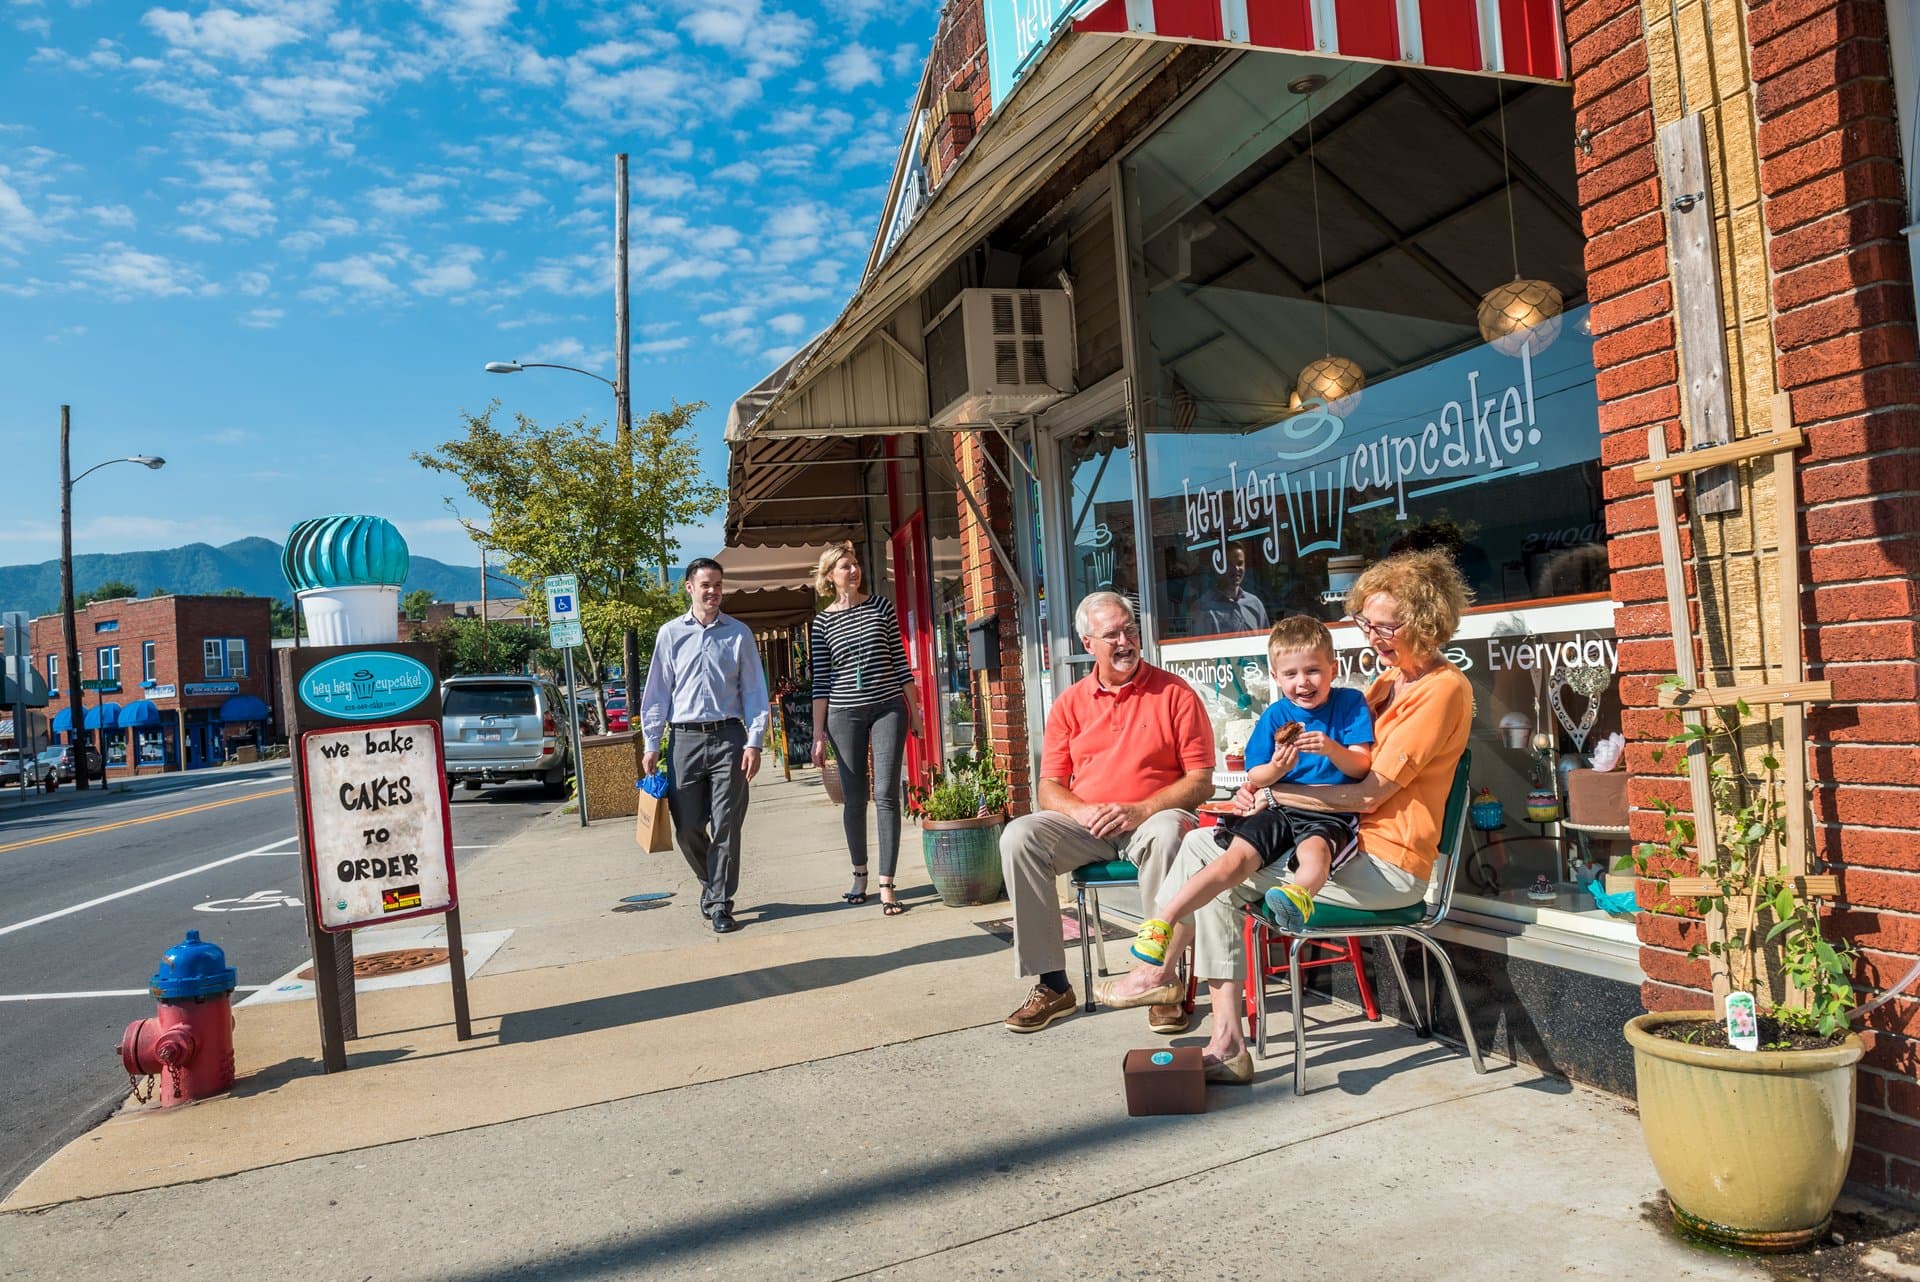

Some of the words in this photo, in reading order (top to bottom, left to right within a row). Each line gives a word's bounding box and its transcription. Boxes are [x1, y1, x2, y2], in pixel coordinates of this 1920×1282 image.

[1182, 477, 1228, 575] hey
[1229, 461, 1280, 564] hey
[1351, 341, 1542, 521] cupcake!
[1487, 633, 1623, 676] Everyday
[312, 680, 332, 703] hey
[333, 678, 352, 701] hey
[375, 669, 422, 694] cupcake!
[365, 729, 413, 755] bake
[340, 776, 412, 811] CAKES
[363, 828, 390, 845] TO
[337, 853, 418, 882] ORDER
